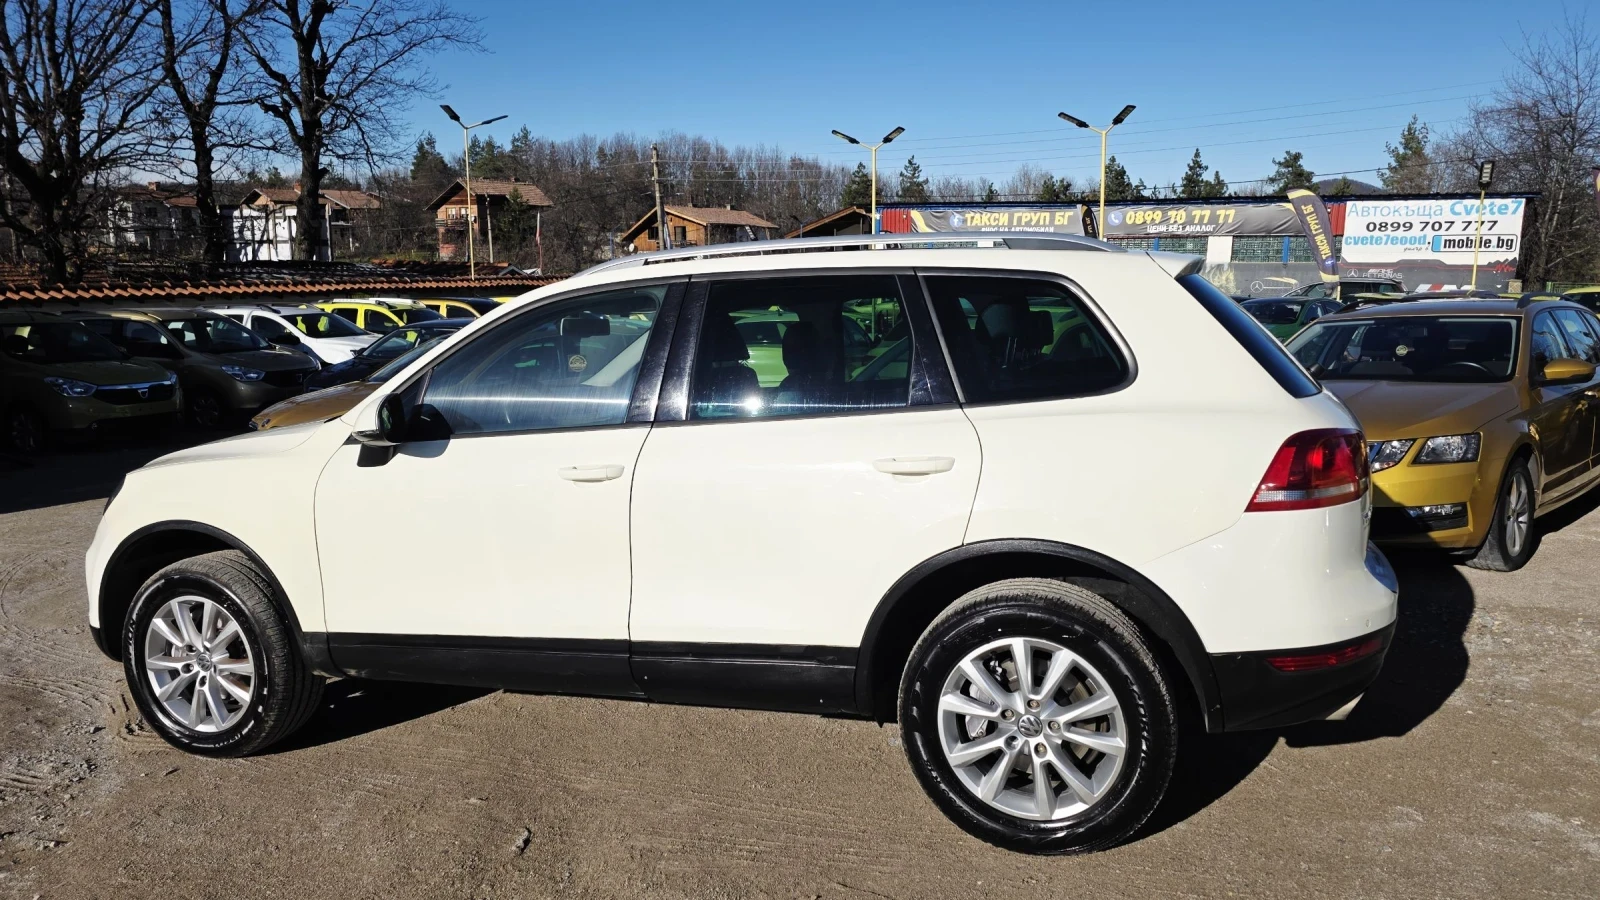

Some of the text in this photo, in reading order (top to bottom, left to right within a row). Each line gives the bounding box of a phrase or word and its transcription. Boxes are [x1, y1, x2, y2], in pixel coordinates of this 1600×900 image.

[1125, 208, 1236, 225] 0899 70 77 77
[1347, 199, 1523, 219] Автокъща Cvete7
[965, 211, 1009, 226] ТАКСИ
[1013, 211, 1050, 226] ГРУП
[1054, 211, 1074, 225] БГ
[1365, 220, 1499, 233] 0899 707 777
[1184, 224, 1216, 232] АНАЛОГ
[1301, 204, 1332, 260] ТАКСИ ГРУП БГ
